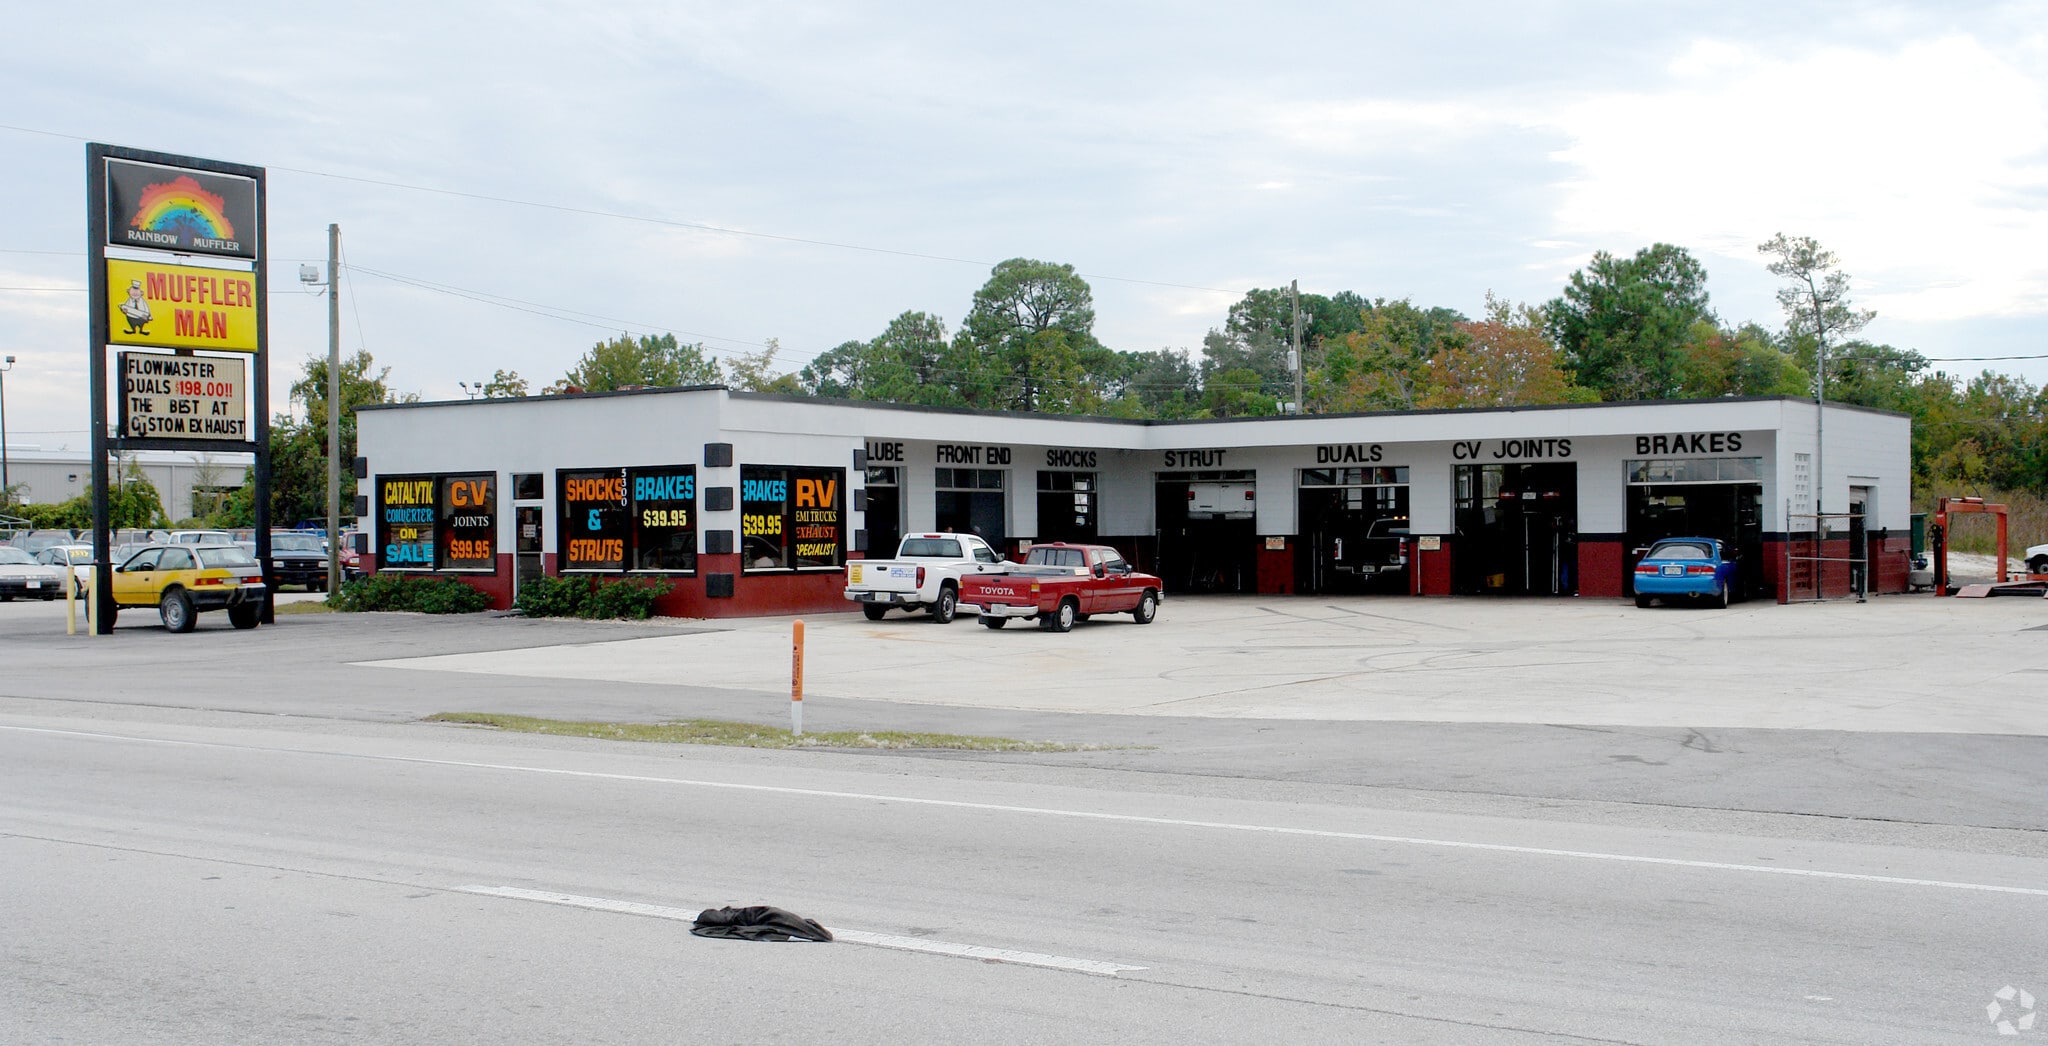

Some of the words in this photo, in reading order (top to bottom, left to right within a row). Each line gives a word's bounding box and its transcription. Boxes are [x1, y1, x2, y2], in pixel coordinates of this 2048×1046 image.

[128, 230, 178, 244] RAINBOW
[193, 237, 240, 251] MUFFLER
[146, 272, 252, 308] MUFFLER
[175, 308, 227, 339] MAN
[128, 359, 215, 378] FLOWMASTER
[127, 378, 171, 395] DUALS
[131, 398, 152, 413] THE
[169, 399, 199, 414] BEST
[212, 401, 228, 416] AT
[866, 442, 904, 462] LUBE
[1452, 441, 1482, 460] CV
[1493, 438, 1572, 459] JOINTS
[1636, 432, 1742, 455] BRAKES
[936, 445, 982, 464] FRONT
[987, 446, 1011, 465] END
[1046, 450, 1097, 468] SHOCKS
[1164, 450, 1226, 467] STRUT
[1317, 445, 1383, 464] DUALS
[385, 481, 434, 505] CATALYTIC
[451, 480, 488, 507] CV
[566, 478, 623, 501] SHOCKS
[635, 475, 694, 500] BRAKES
[743, 480, 787, 501] BRAKES
[796, 479, 836, 508] RV
[453, 516, 489, 527] JOINTS
[588, 509, 602, 531] &
[643, 509, 687, 528] $39.95
[743, 513, 782, 536] $39.95
[810, 511, 837, 522] TRUCKS
[400, 528, 418, 540] ON
[386, 544, 434, 563] SALE
[450, 539, 490, 560] $99.95
[569, 539, 623, 562] STRUTS
[979, 587, 1014, 596] TOYOTA
